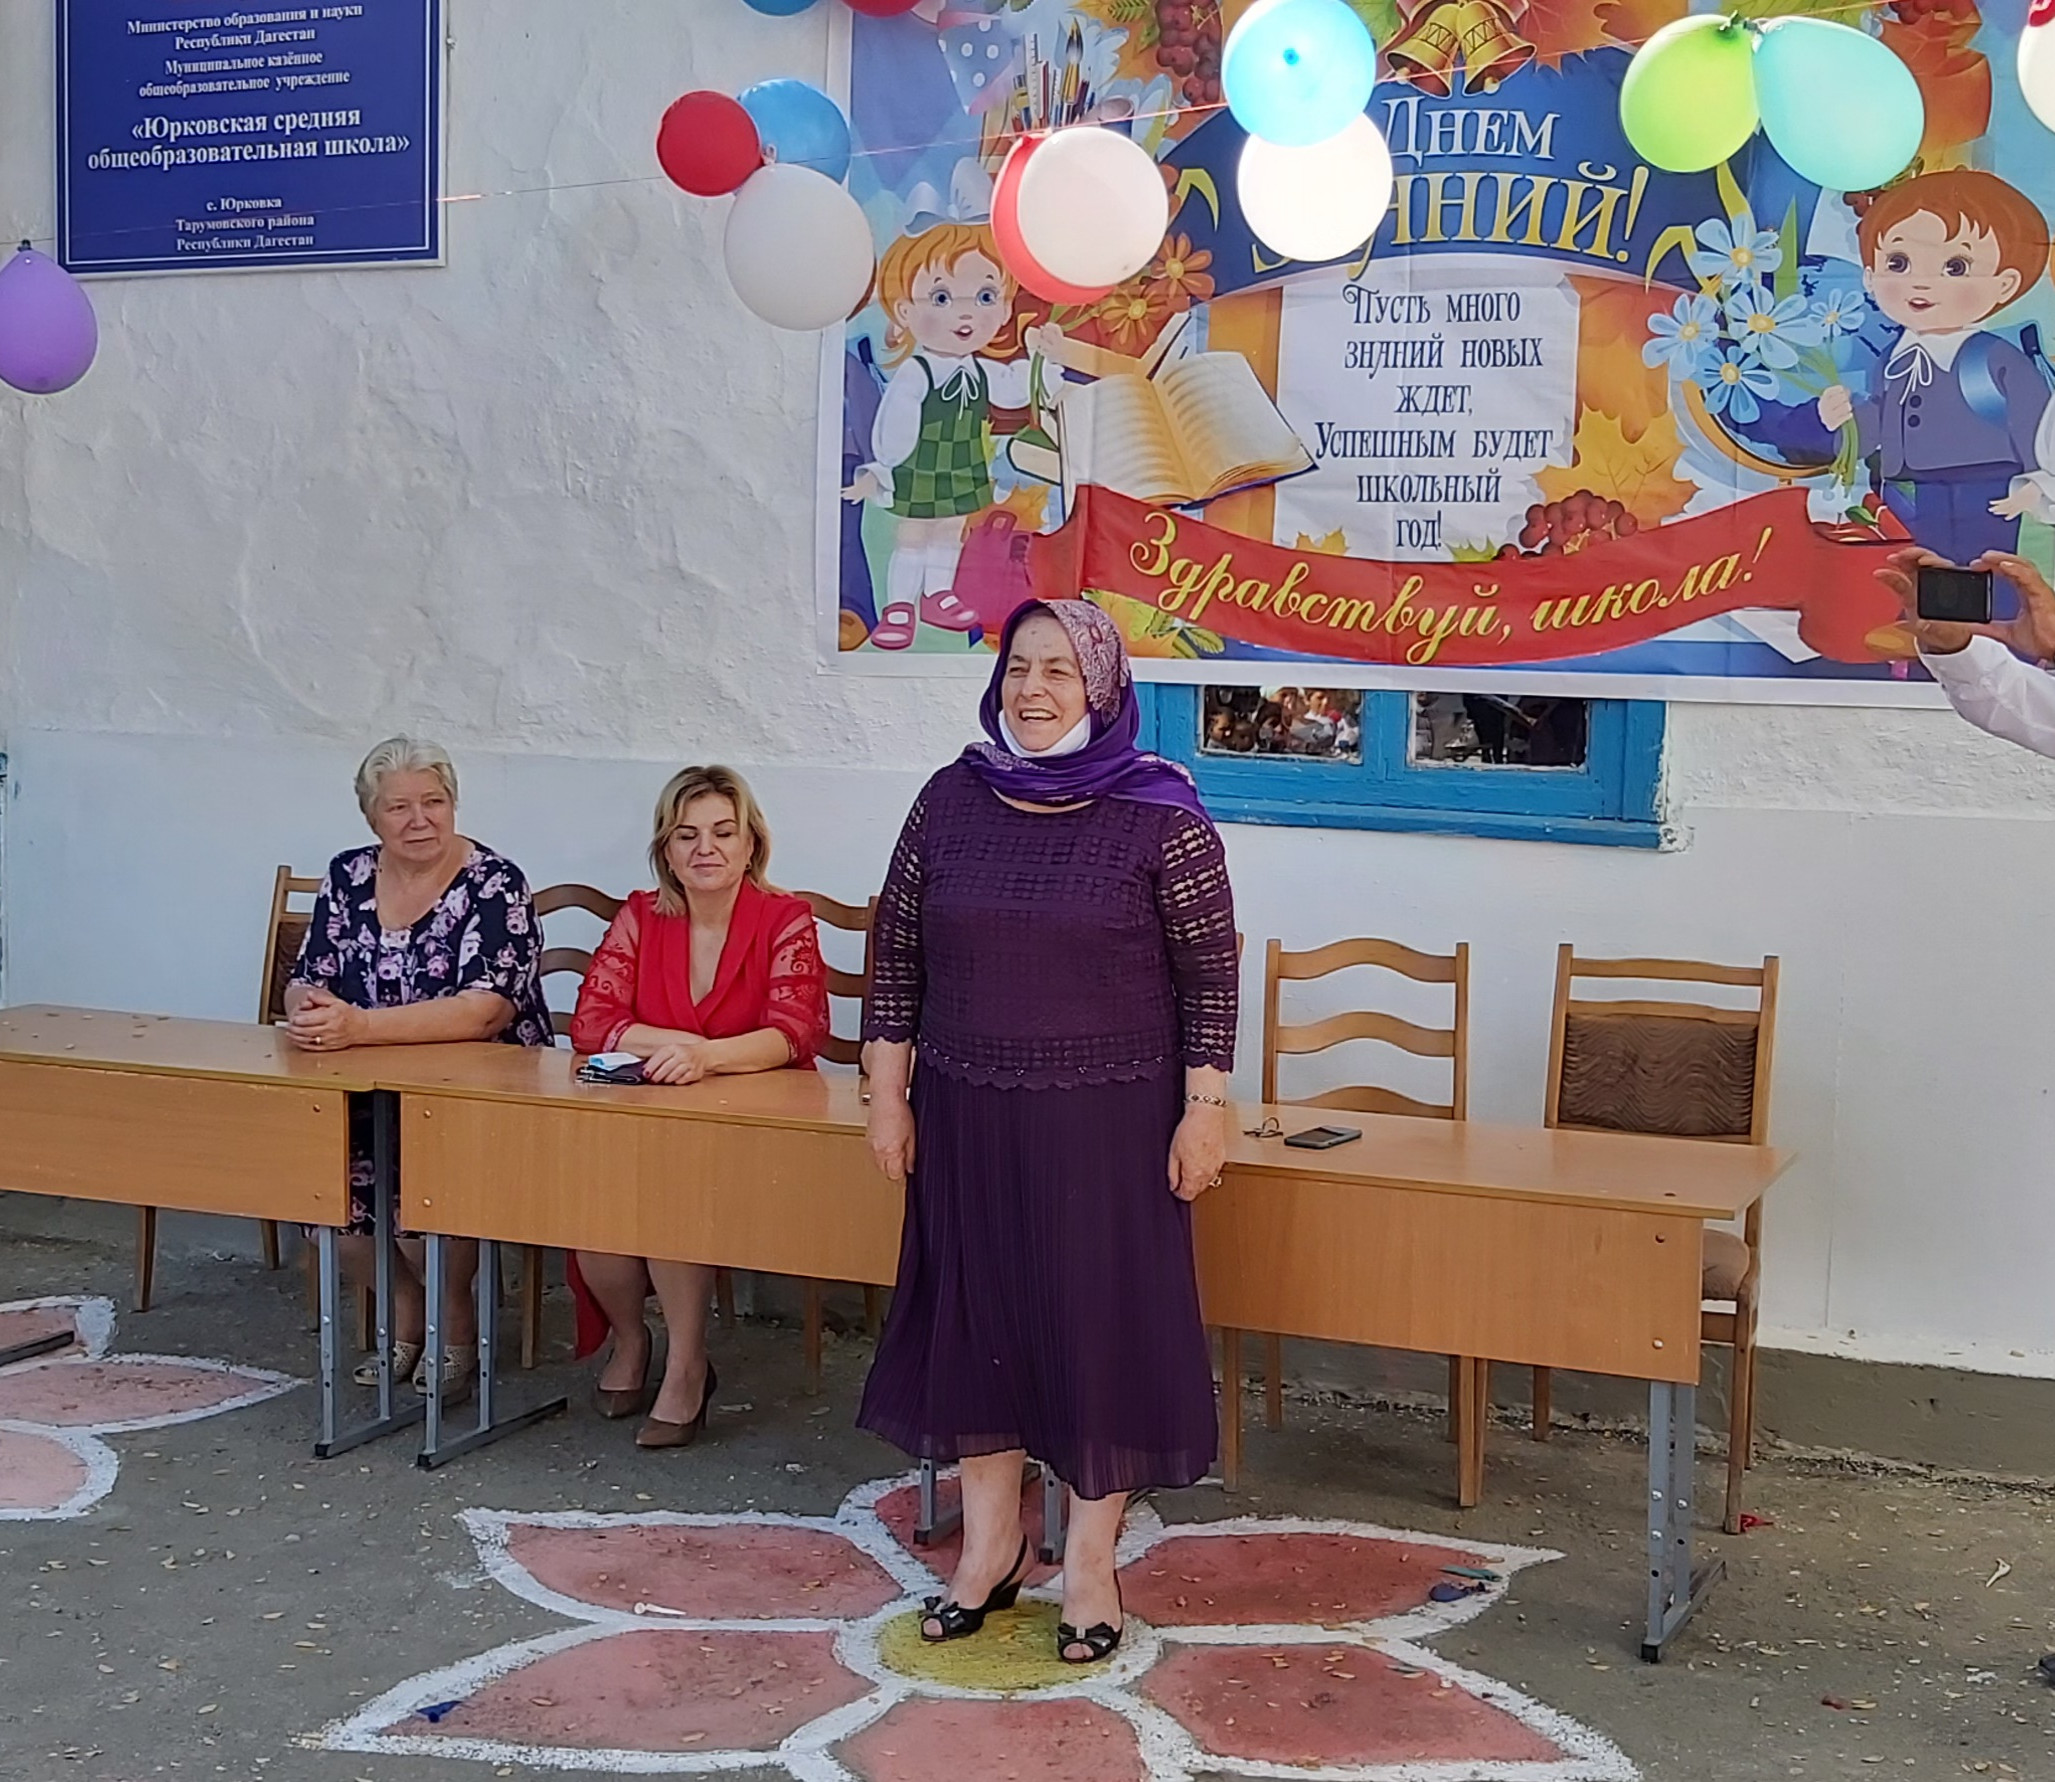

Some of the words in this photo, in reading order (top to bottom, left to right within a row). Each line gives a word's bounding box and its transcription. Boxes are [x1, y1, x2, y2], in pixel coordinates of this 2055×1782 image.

[127, 16, 221, 34] Министерство
[224, 10, 307, 29] образования
[310, 8, 319, 20] и
[322, 5, 363, 20] науки
[175, 33, 251, 51] Республики
[254, 28, 316, 46] Дагестан
[165, 55, 265, 76] Муниципальное
[268, 51, 323, 68] казённое
[139, 78, 270, 98] общеобразовательное
[275, 70, 351, 91] учреждение
[131, 115, 268, 141] «Юрковская
[273, 109, 361, 131] средняя
[88, 138, 317, 170] общеобразовательная
[323, 134, 411, 156] школа»
[206, 201, 217, 211] с.
[220, 196, 283, 212] Юрковка
[175, 216, 265, 233] Тарумовского
[268, 214, 315, 229] района
[176, 235, 252, 252] Республики
[254, 233, 314, 249] Дагестан
[1129, 511, 1512, 665] Здравствуй,
[1530, 526, 1774, 633] школа!
